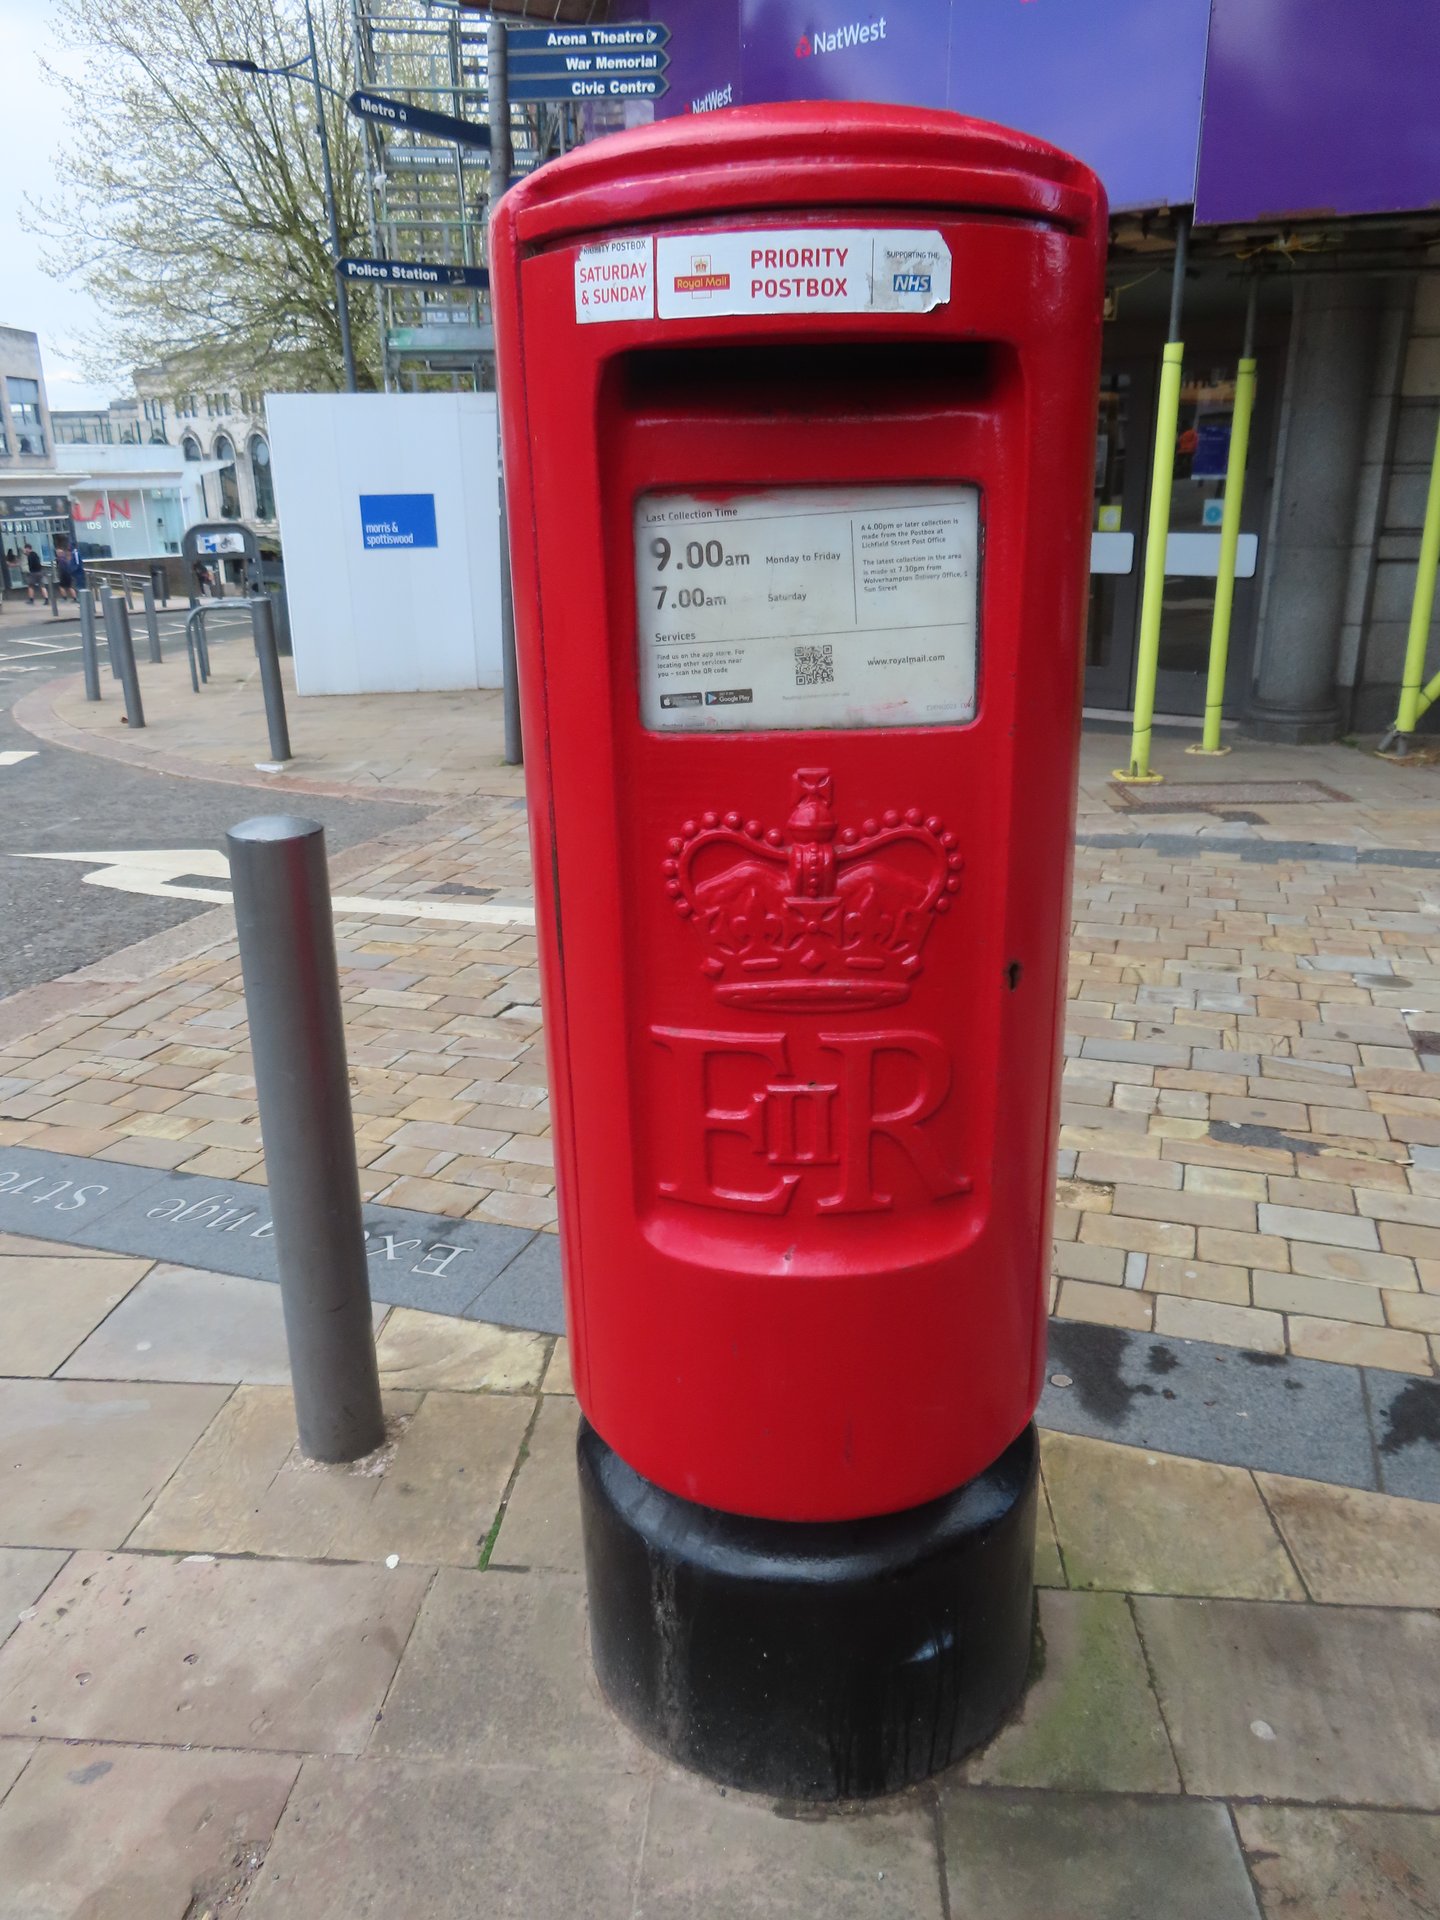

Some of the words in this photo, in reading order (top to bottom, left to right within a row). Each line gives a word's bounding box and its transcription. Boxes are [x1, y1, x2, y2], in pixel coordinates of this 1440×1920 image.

[547, 32, 587, 46] Arena
[591, 30, 645, 45] Theatre
[813, 16, 887, 55] NatWest
[566, 57, 592, 71] War
[595, 55, 657, 70] Memorial
[572, 81, 606, 95] Civic
[610, 80, 656, 94] Centre
[692, 82, 733, 114] NatWest
[360, 98, 396, 119] Metro
[612, 240, 646, 252] POSTBOX
[751, 248, 849, 269] PRIORITY
[886, 251, 926, 259] SUPPORTING
[347, 262, 388, 278] Police
[392, 266, 439, 282] Station
[580, 262, 647, 283] SATURDAY
[677, 278, 703, 290] Royal
[705, 276, 727, 288] Mail
[751, 278, 848, 299] POSTBOX
[894, 275, 930, 292] NHS
[581, 290, 590, 305] &
[593, 285, 647, 305] SUNDAY
[646, 514, 666, 522] Last
[668, 510, 713, 520] Collection
[715, 508, 738, 517] Time
[366, 522, 391, 533] morris
[392, 521, 399, 533] &
[867, 523, 894, 531] 4.00pm
[921, 519, 951, 527] collection
[898, 529, 909, 537] the
[910, 528, 935, 536] Postbox
[367, 533, 414, 547] spottiswood
[862, 541, 889, 549] Lichfield
[650, 537, 750, 572] 9.00am
[766, 555, 799, 564] Monday
[814, 552, 840, 560] Friday
[652, 586, 726, 610] 7.00am
[768, 592, 807, 602] Saturday
[655, 632, 696, 643] Services
[657, 662, 682, 670] locating
[867, 653, 946, 666] www.royalmail.com
